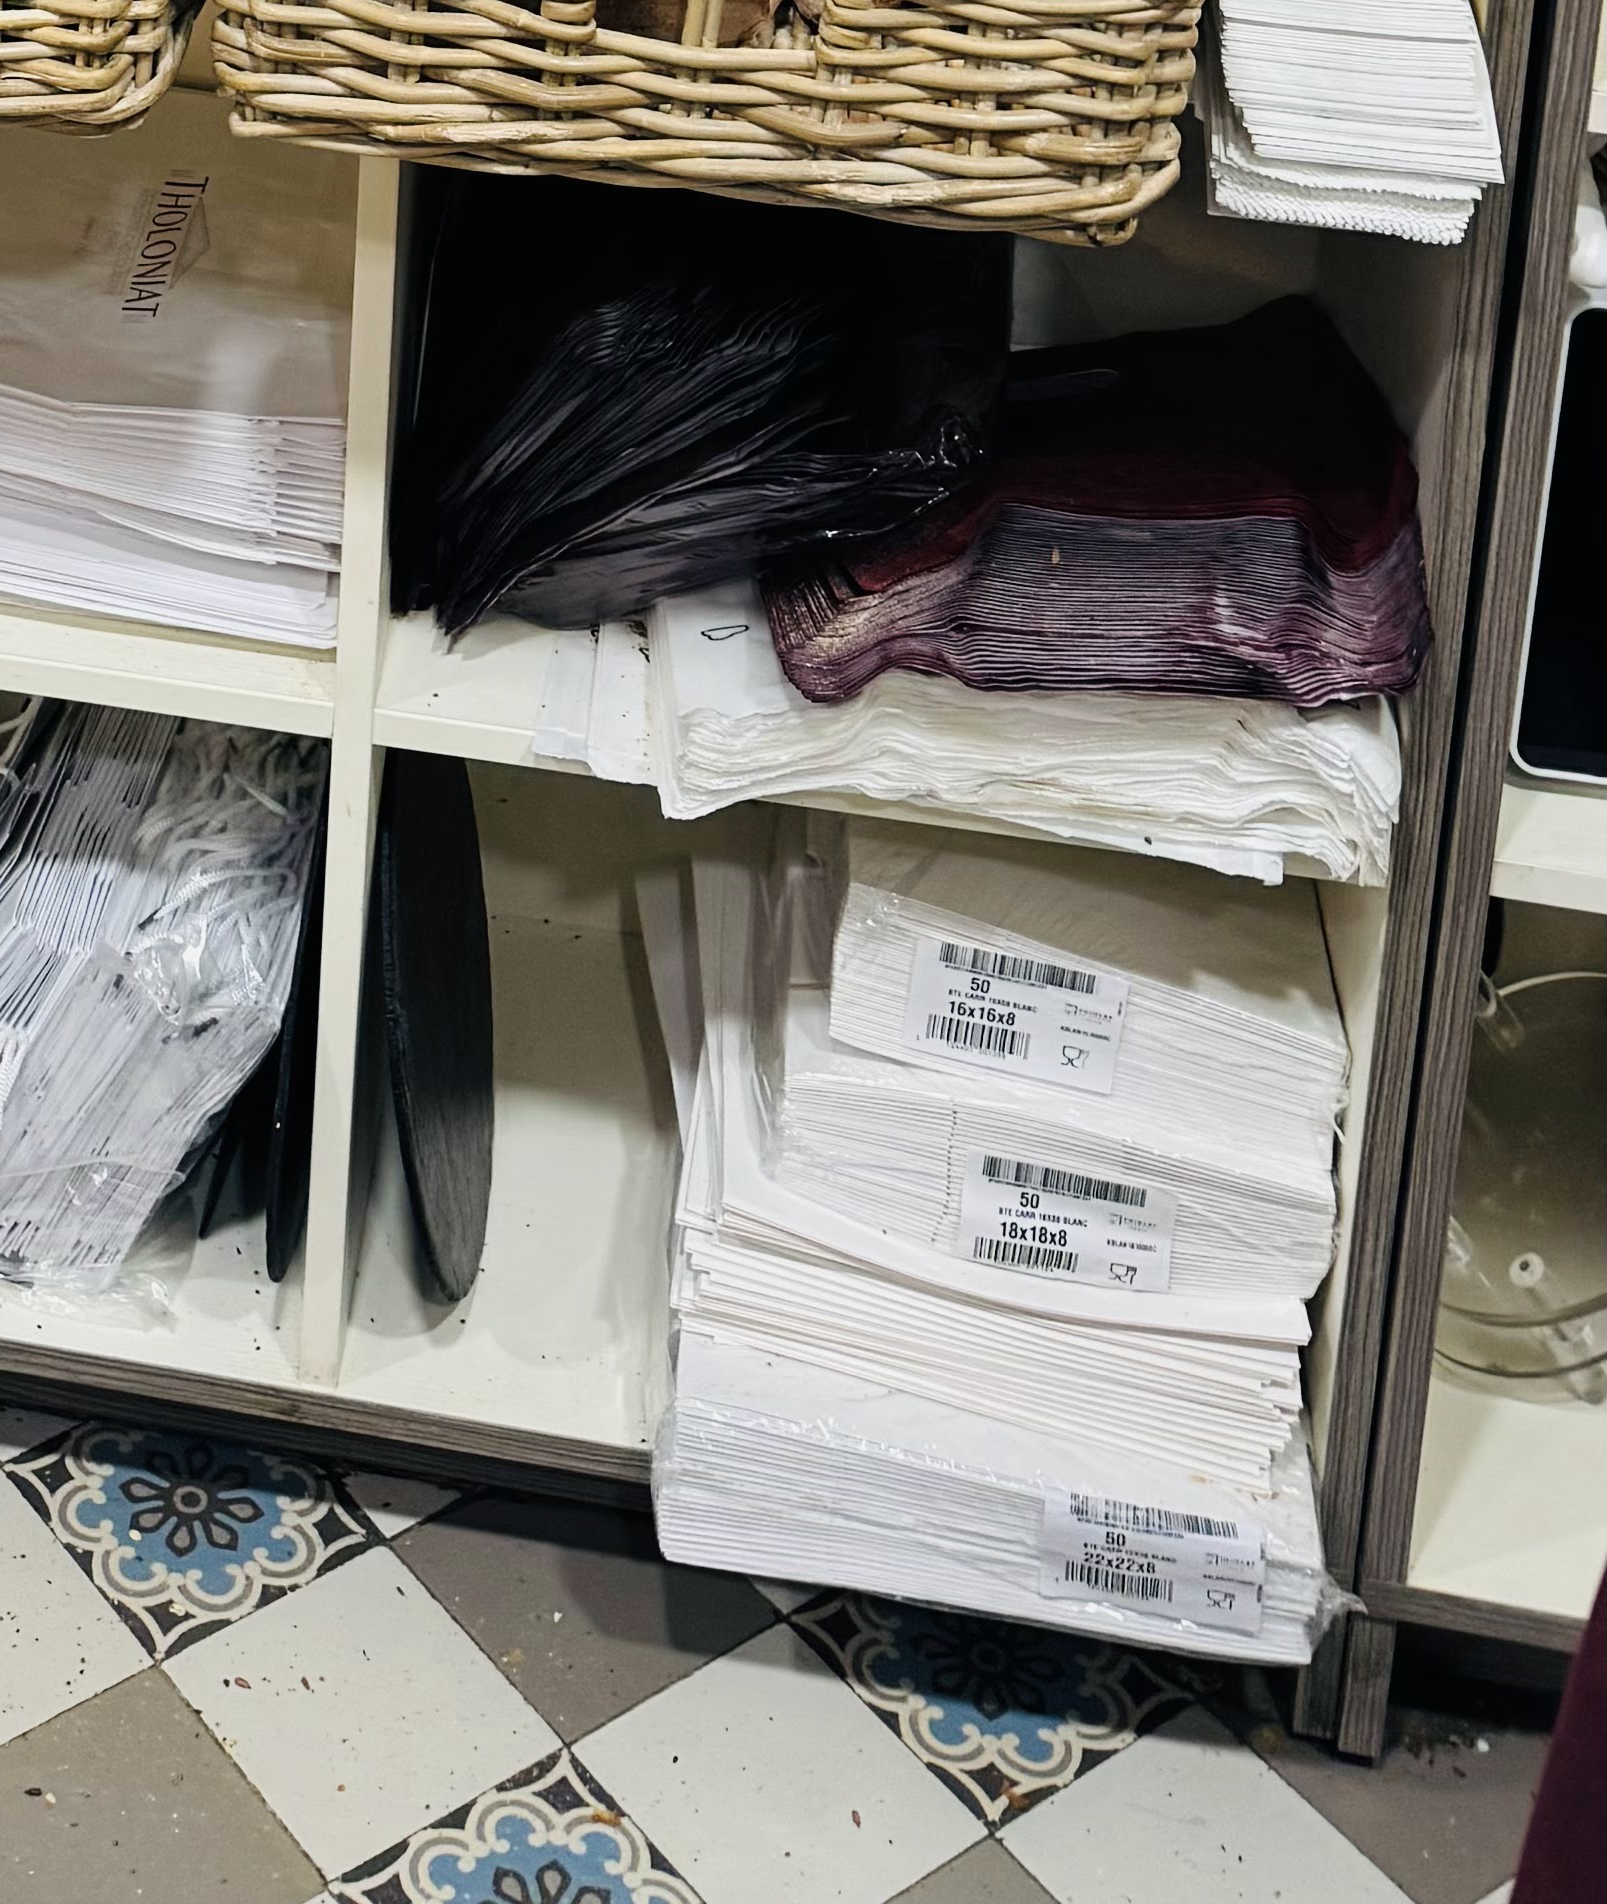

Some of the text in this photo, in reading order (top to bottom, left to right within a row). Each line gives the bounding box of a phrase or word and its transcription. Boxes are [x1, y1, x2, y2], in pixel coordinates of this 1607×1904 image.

[121, 175, 210, 318] THOLONIAT
[970, 977, 991, 994] 50
[948, 1000, 1016, 1026] 16x16x8
[1019, 1192, 1040, 1209] 50
[1000, 1221, 1067, 1247] 18x18x8
[1105, 1531, 1127, 1547] 50
[1083, 1551, 1157, 1575] 22x22x8
